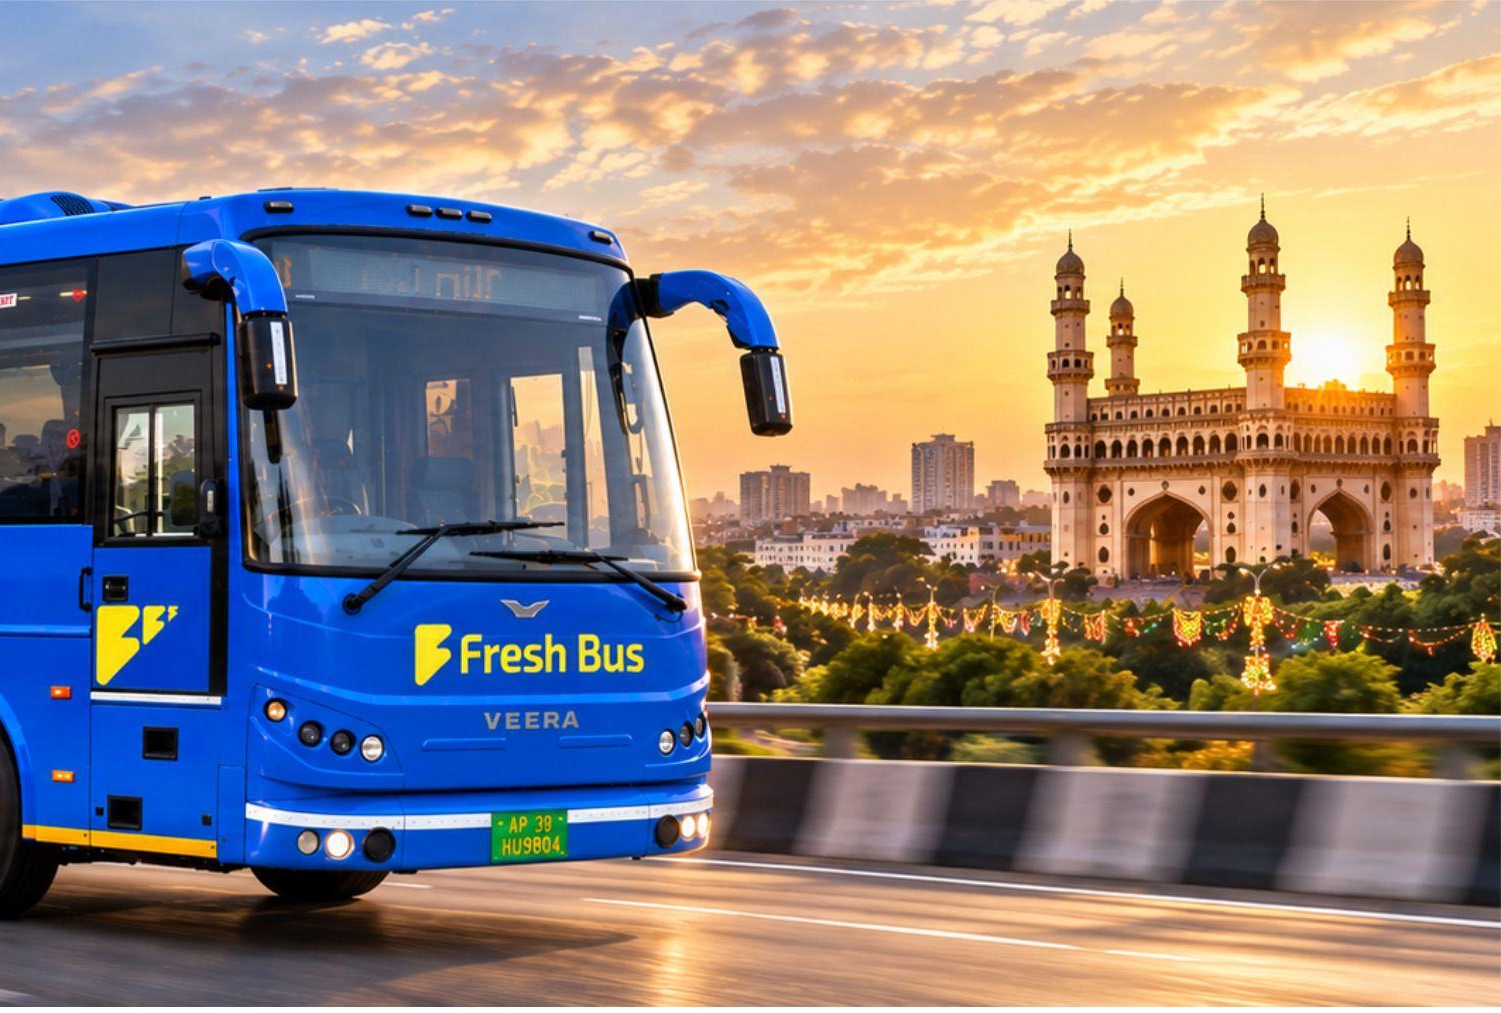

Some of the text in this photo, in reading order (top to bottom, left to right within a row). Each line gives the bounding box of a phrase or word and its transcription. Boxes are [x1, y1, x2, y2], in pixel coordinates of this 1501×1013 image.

[460, 633, 645, 674] Fresh Bus
[484, 711, 579, 730] VEERA
[509, 816, 528, 834] AP
